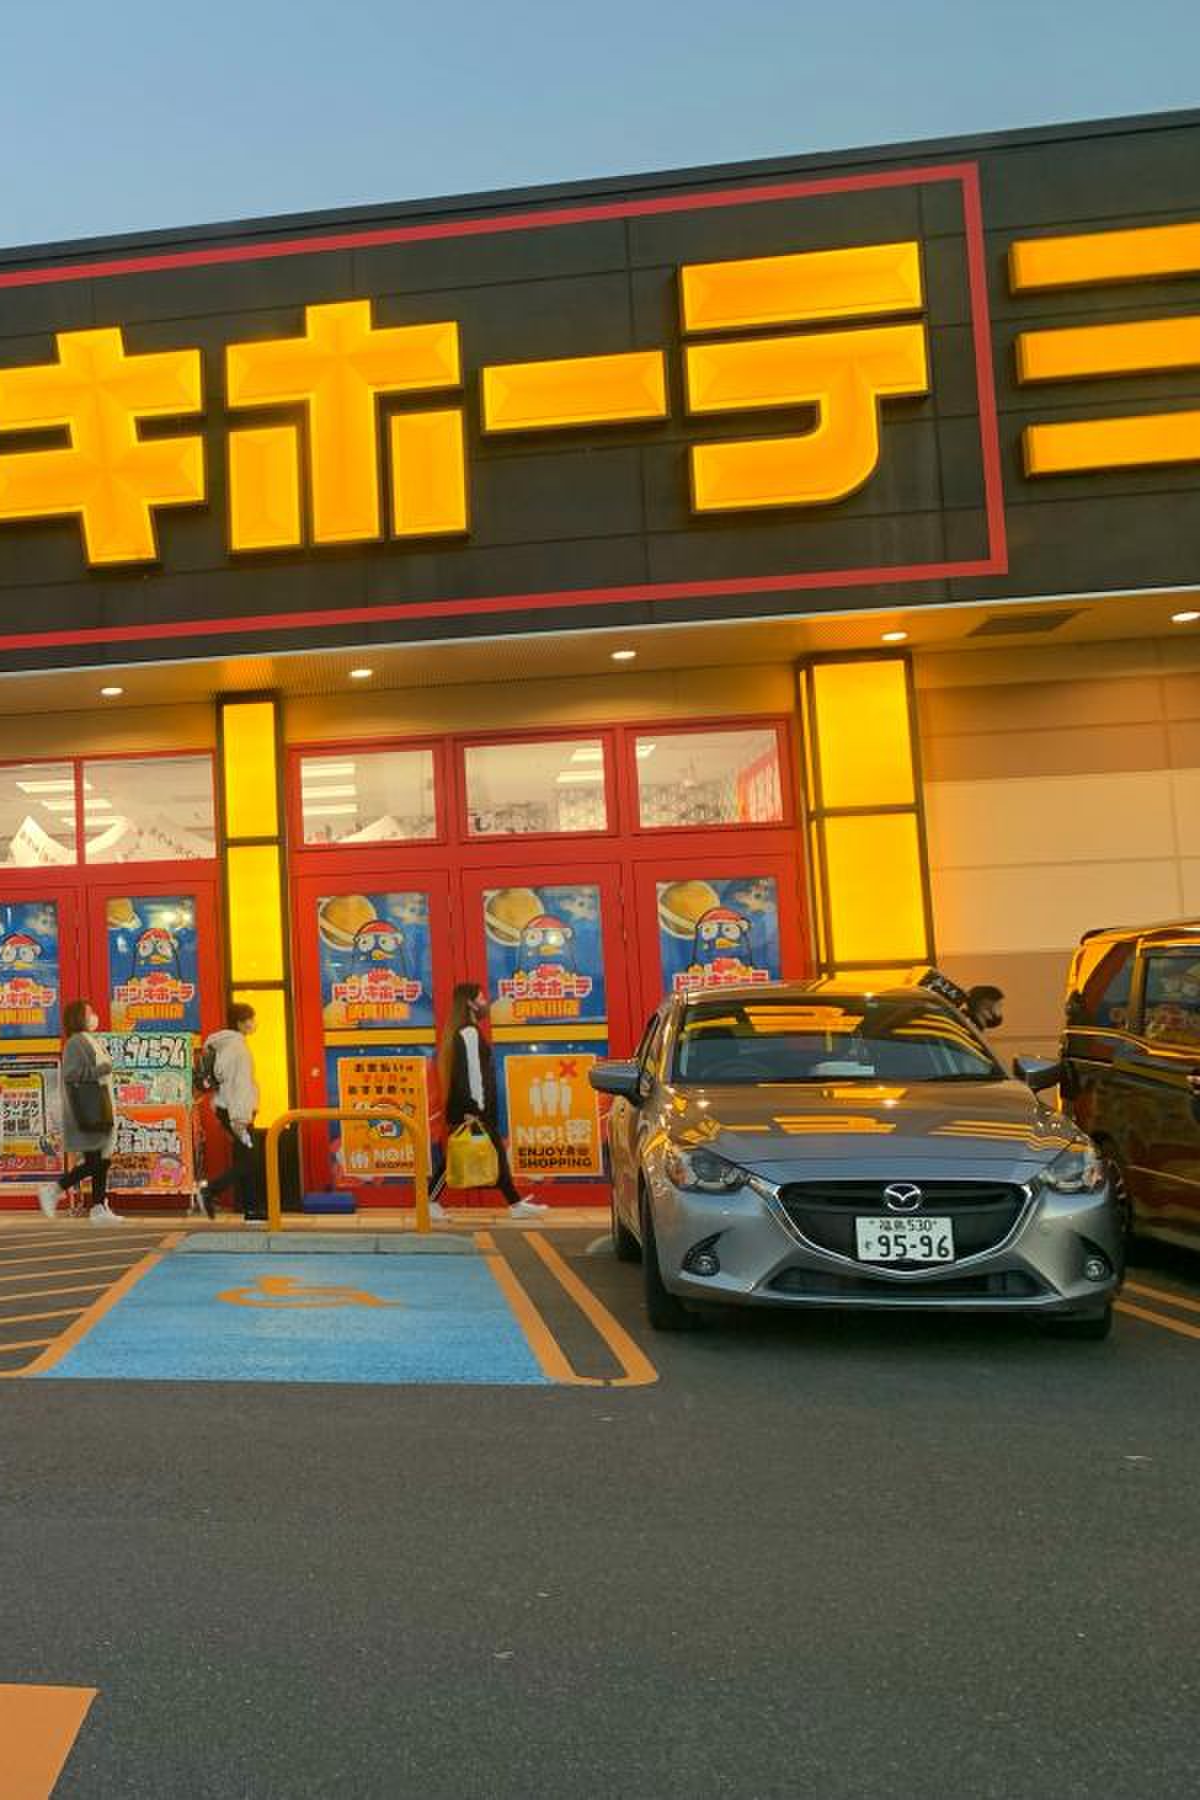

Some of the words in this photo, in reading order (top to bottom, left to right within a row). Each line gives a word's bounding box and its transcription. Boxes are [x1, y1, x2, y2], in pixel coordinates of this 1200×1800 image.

[517, 1156, 593, 1169] SHOPPING
[907, 1218, 933, 1232] 530
[877, 1234, 951, 1259] 95-96
